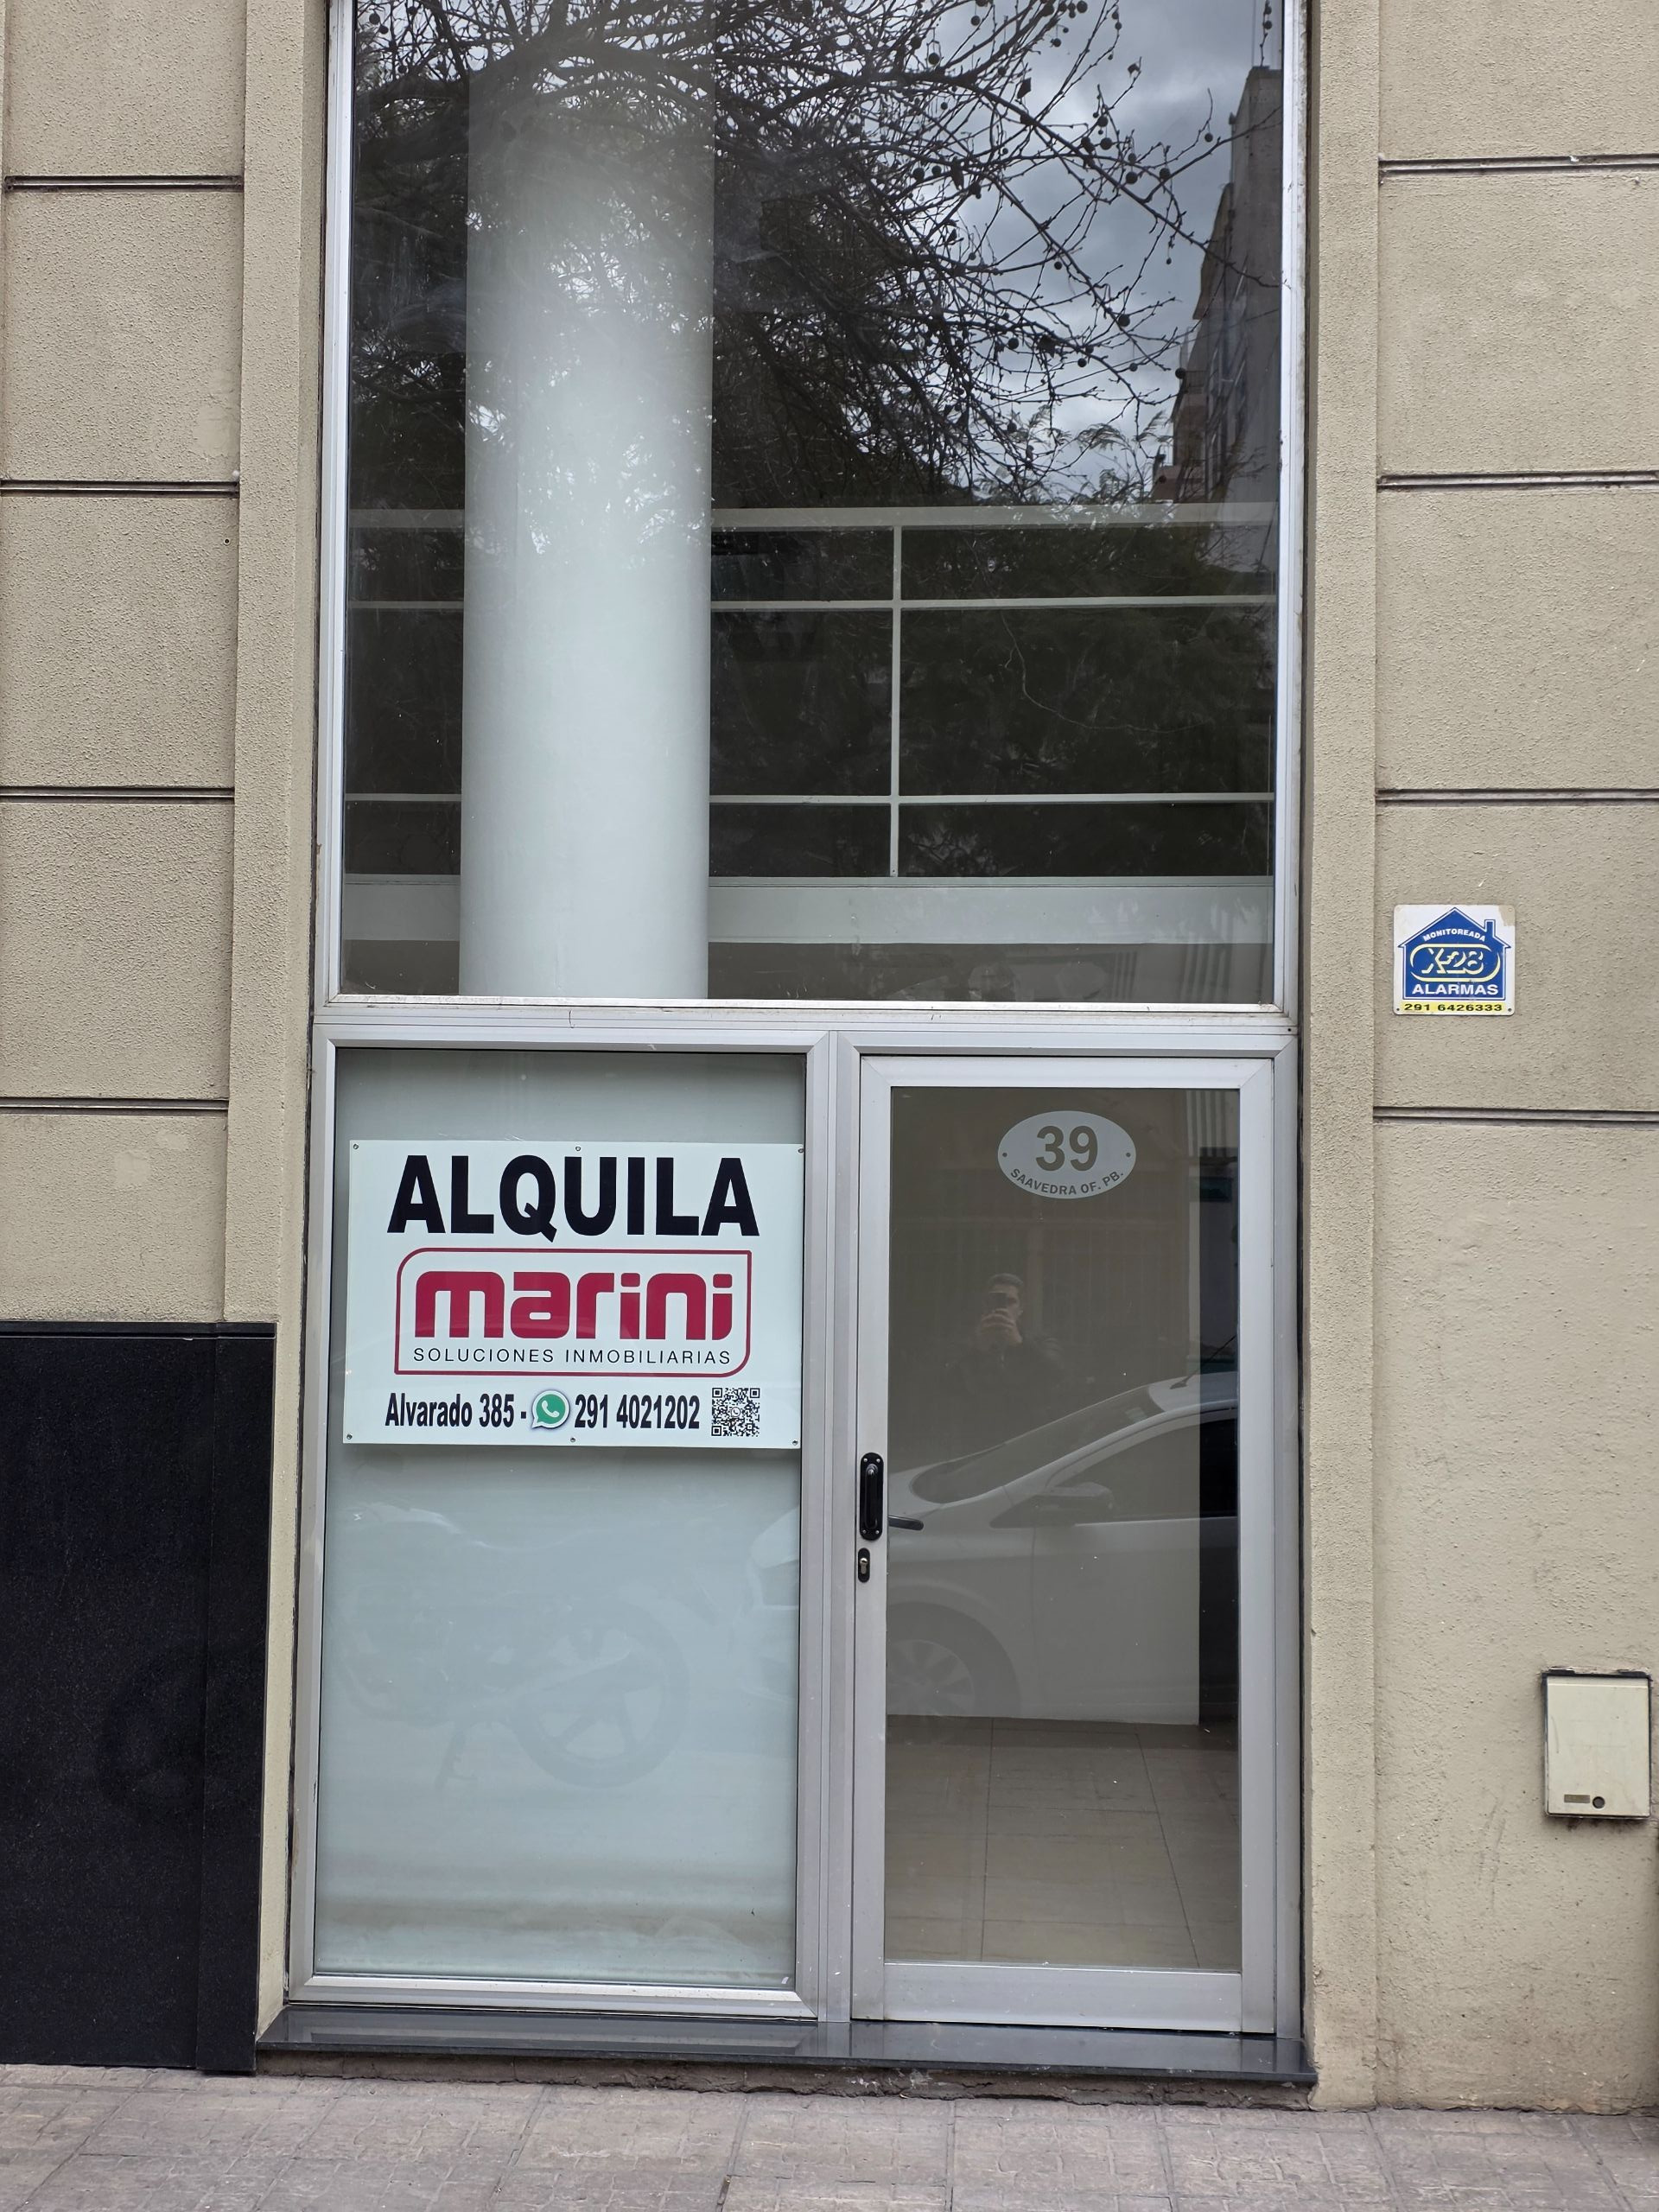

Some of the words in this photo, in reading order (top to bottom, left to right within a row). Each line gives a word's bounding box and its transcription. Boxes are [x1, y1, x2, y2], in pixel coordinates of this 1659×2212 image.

[1422, 928, 1486, 942] MONITOREADA
[1412, 983, 1499, 995] ALARMAS
[1404, 1003, 1431, 1012] 291
[1437, 1003, 1503, 1012] 6426333
[1035, 1125, 1098, 1172] 39
[1010, 1168, 1077, 1195] SAAVEDRA
[1080, 1181, 1102, 1194] OF.
[1103, 1170, 1124, 1187] PB.
[386, 1154, 760, 1243] ALQUILA
[414, 1270, 734, 1341] marini
[413, 1347, 555, 1363] SOLUCIONES
[565, 1349, 731, 1365] INMOBILIARIAS
[385, 1392, 474, 1427] Alvarado
[479, 1394, 515, 1427] 385
[575, 1394, 608, 1429] 291
[616, 1394, 701, 1430] 4021202
